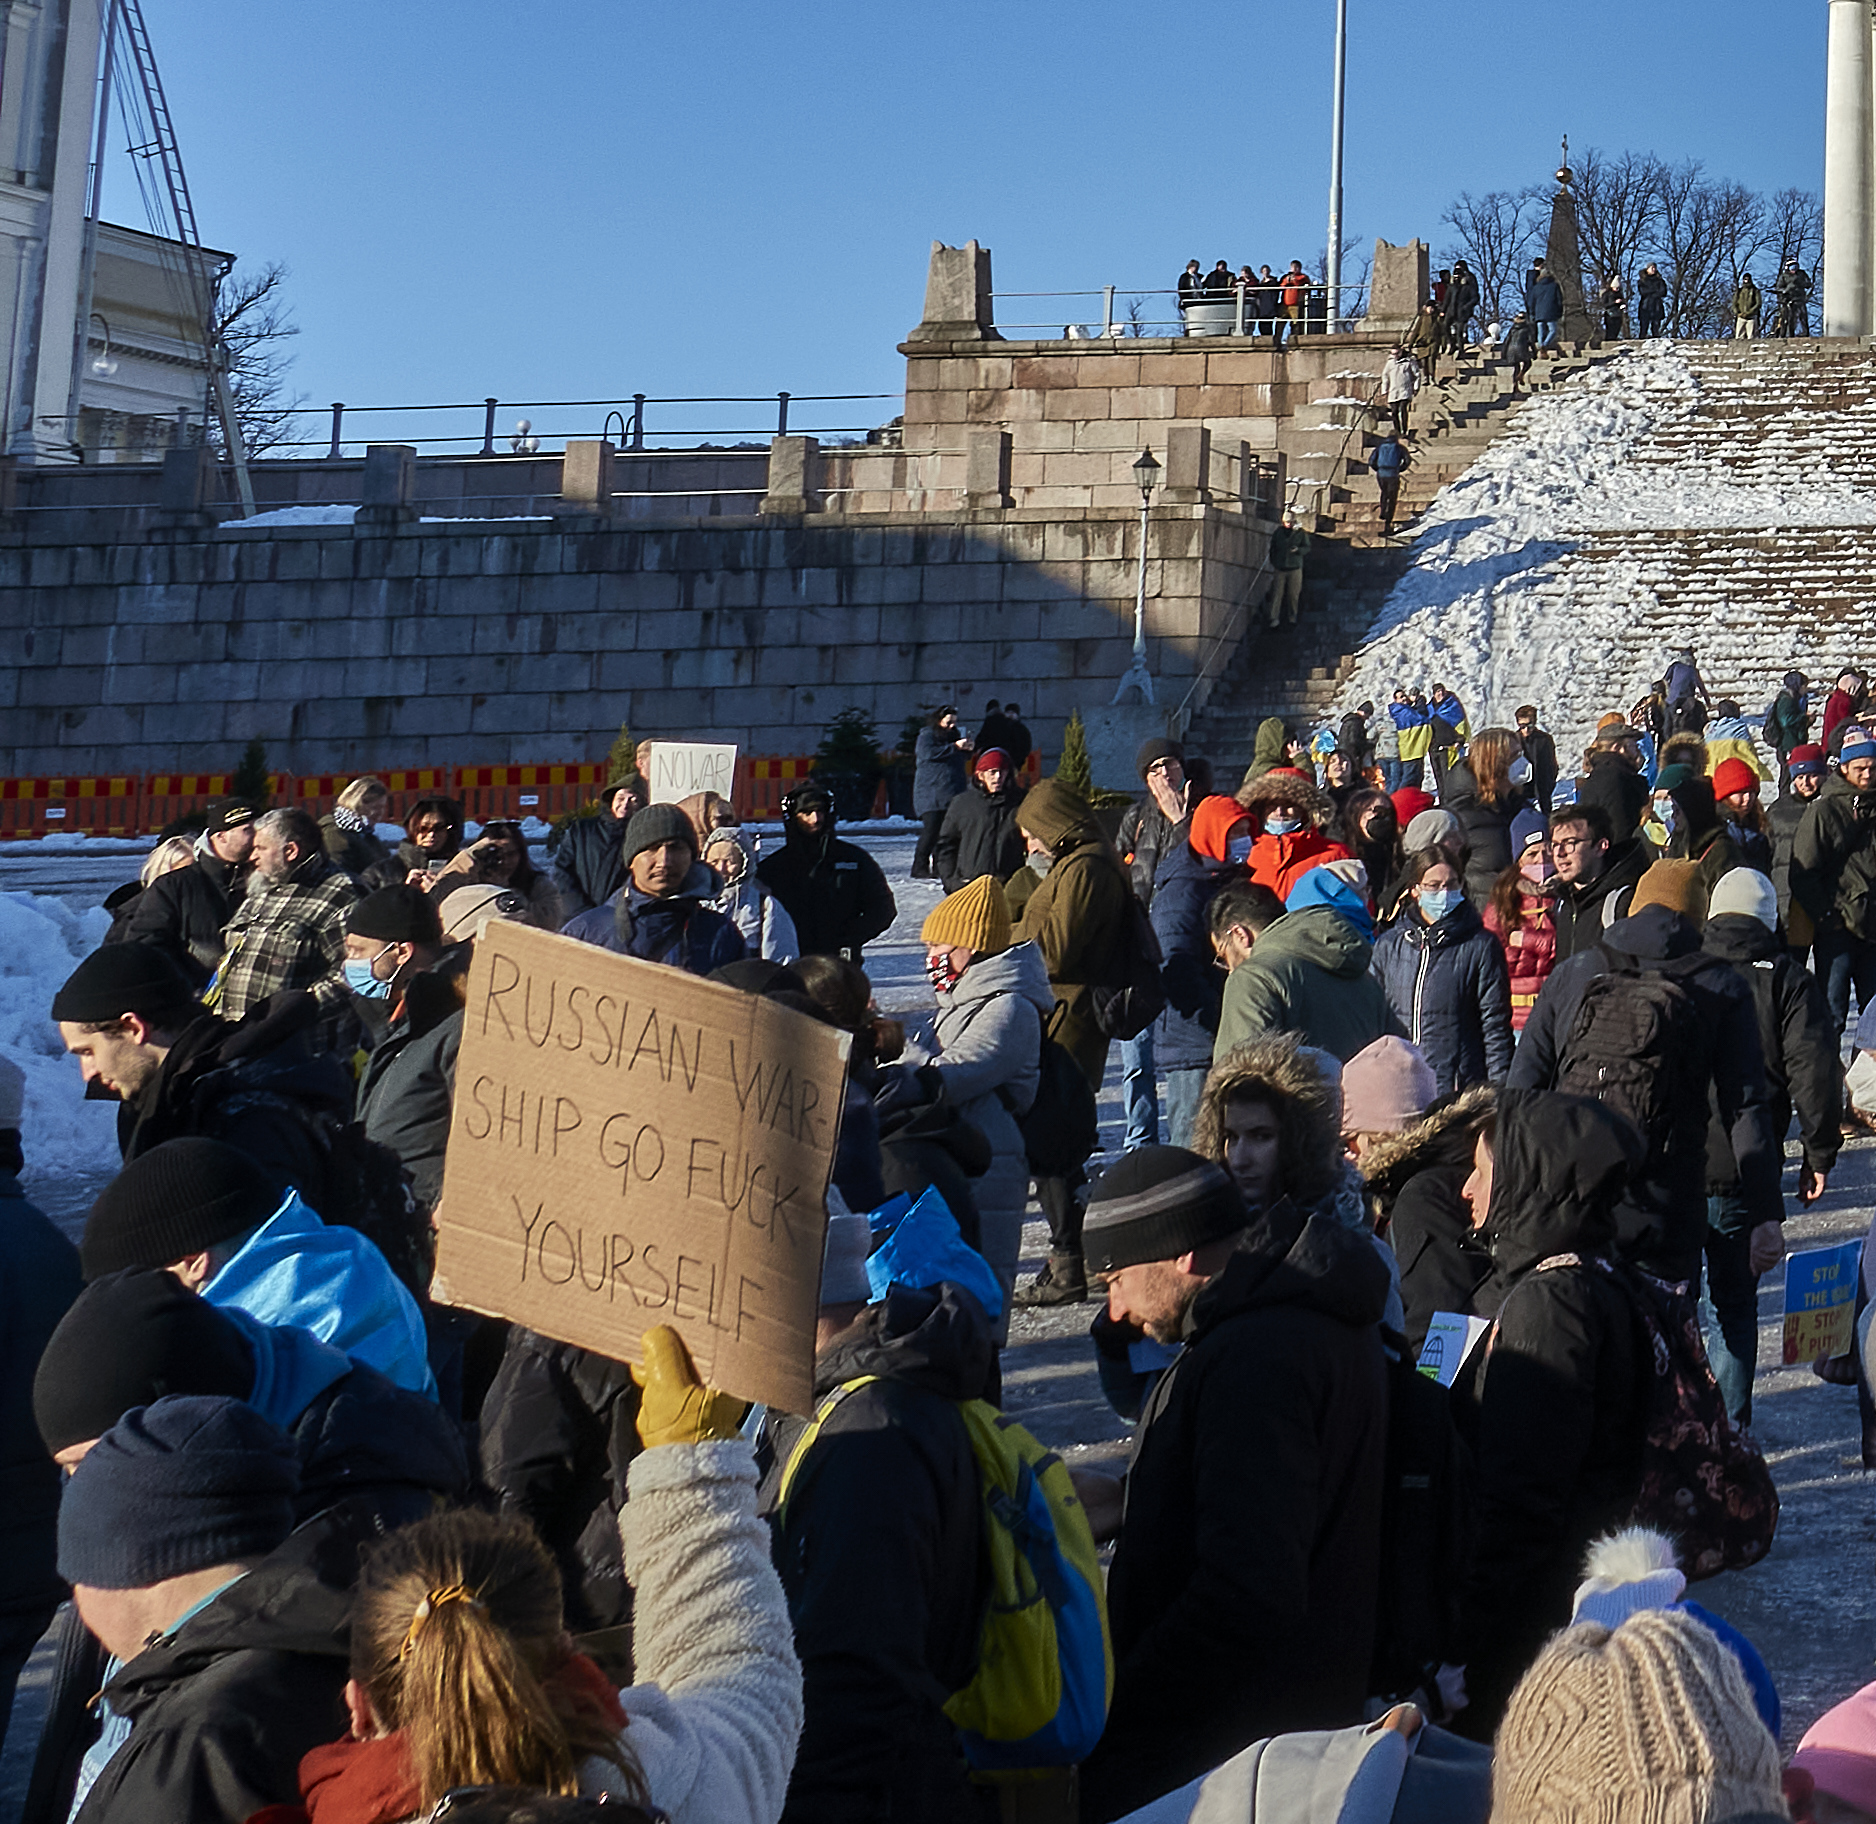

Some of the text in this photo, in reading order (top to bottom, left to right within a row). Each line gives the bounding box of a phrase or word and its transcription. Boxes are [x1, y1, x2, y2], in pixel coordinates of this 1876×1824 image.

[689, 750, 732, 793] WAR
[483, 953, 828, 1148] RUSSIAN WAR-
[465, 1075, 799, 1246] SHIP GO FUCK
[511, 1194, 765, 1343] YOURSELF
[1804, 1289, 1828, 1308] THE
